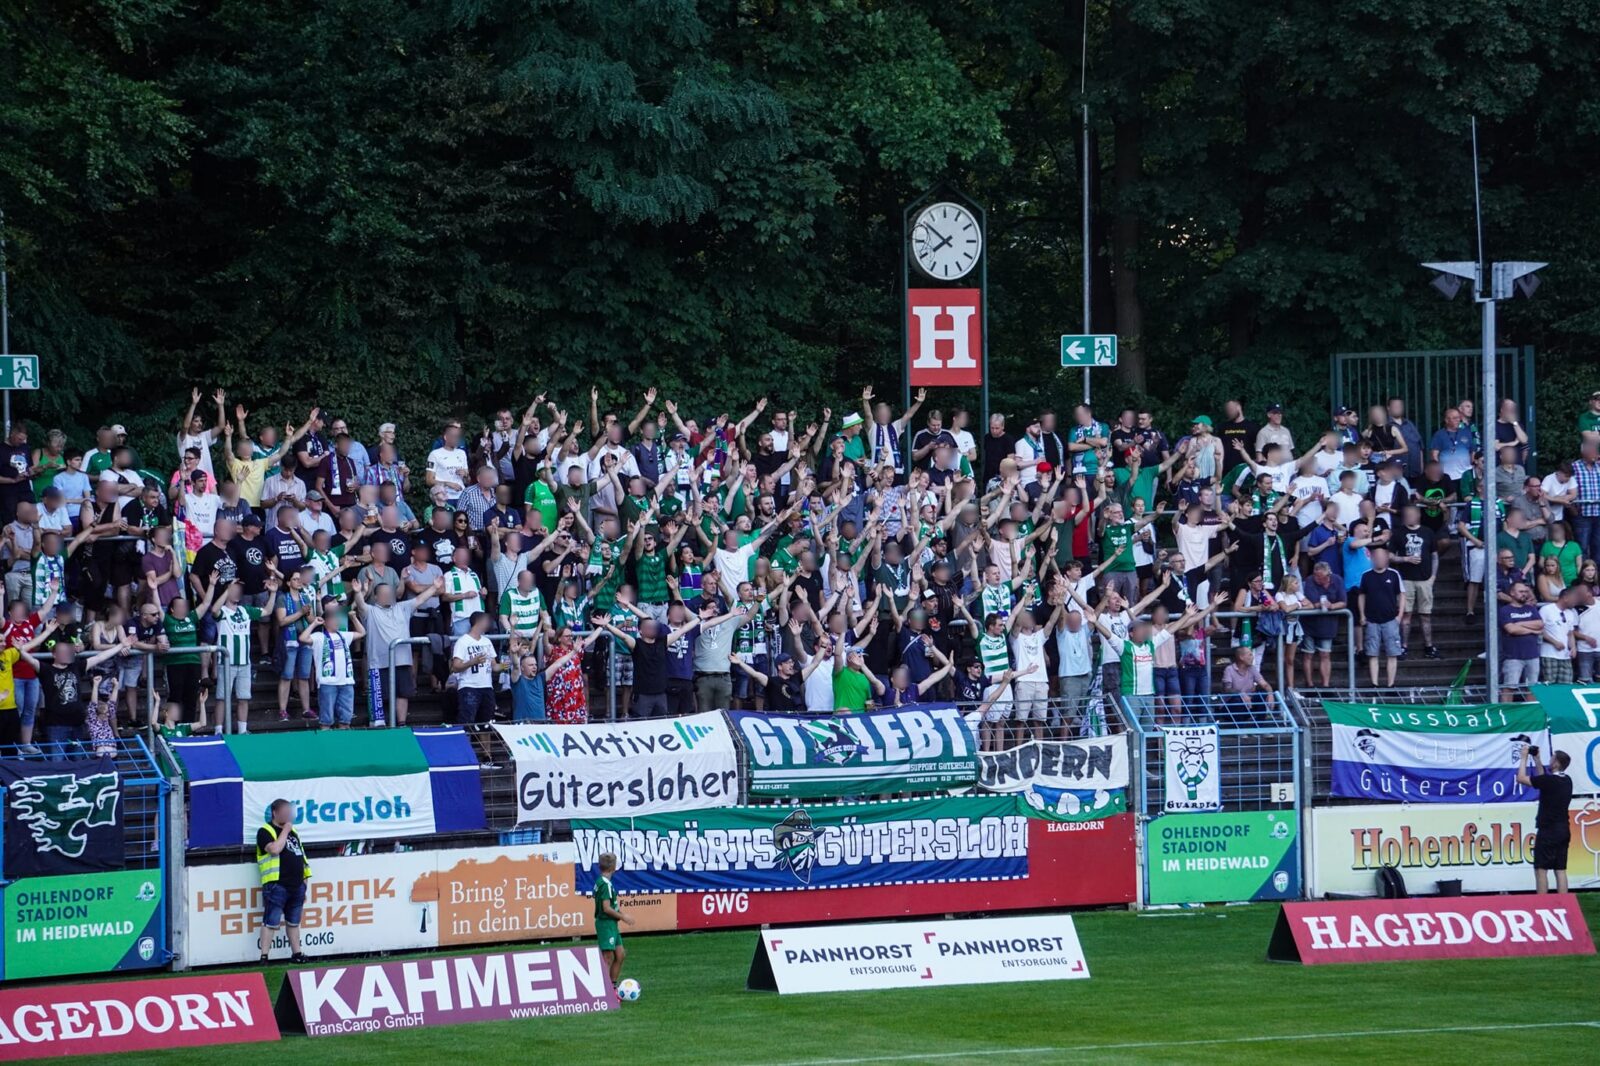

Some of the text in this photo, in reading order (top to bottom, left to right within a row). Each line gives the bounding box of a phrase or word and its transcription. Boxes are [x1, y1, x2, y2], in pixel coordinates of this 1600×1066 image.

[912, 306, 976, 368] H
[1368, 708, 1507, 728] Fussball
[562, 730, 681, 757] Aktive
[740, 708, 968, 767] GT LEBT
[1415, 739, 1475, 762] Club
[520, 762, 736, 811] Gütersloher
[1361, 769, 1524, 796] Gütersloh
[1167, 801, 1217, 809] GUARDIA
[1278, 789, 1287, 801] 5
[1047, 820, 1105, 832] HAGEDORN
[1162, 825, 1250, 840] OHLENDORF
[573, 816, 1029, 872] VORWÄRTS GÜTERSLOH
[1162, 840, 1227, 854] STADION
[1162, 856, 1269, 872] IM HEIDEWALD
[16, 887, 114, 906] OHLENDORF
[515, 875, 570, 901] Farbe
[619, 898, 661, 908] Fachmann
[701, 892, 749, 915] GWG
[16, 905, 88, 923] STADION
[452, 905, 584, 936] in dein Leben
[16, 921, 134, 943] IM HEIDEWALD
[1302, 908, 1573, 950] HAGEDORN
[784, 943, 912, 964] PANNHORST
[937, 937, 1063, 957] PANNHORST
[850, 964, 917, 976] ENTSORGUNG
[1001, 957, 1068, 968] ENTSORGUNG
[300, 946, 606, 1023] KAHMEN
[510, 1000, 608, 1019] www.kahmen.de
[306, 1013, 424, 1036] TransCargo GmbH
